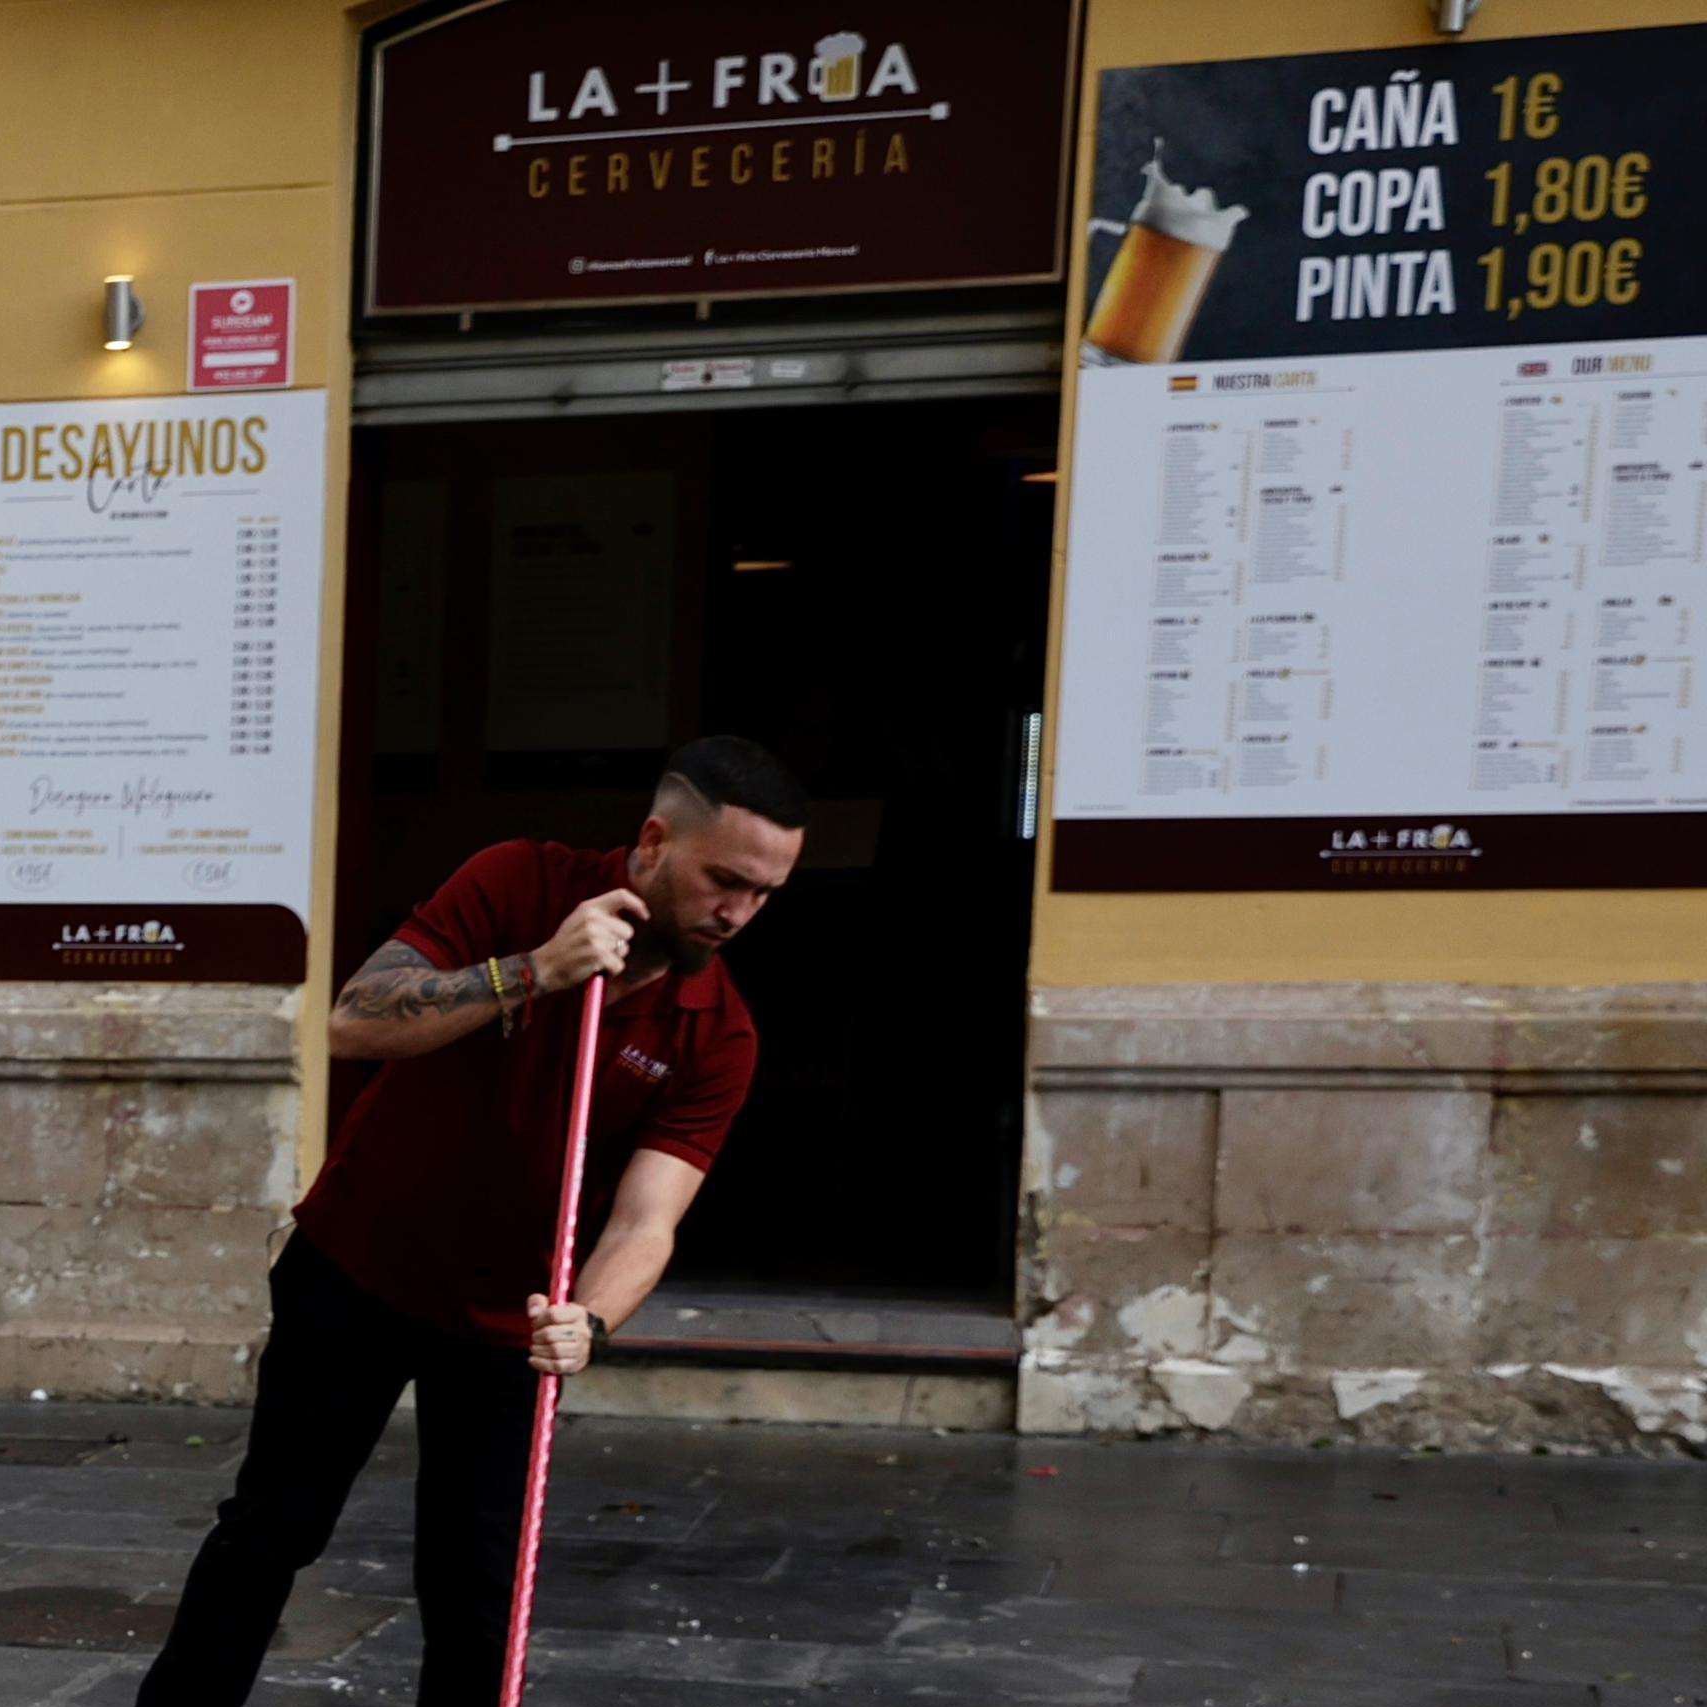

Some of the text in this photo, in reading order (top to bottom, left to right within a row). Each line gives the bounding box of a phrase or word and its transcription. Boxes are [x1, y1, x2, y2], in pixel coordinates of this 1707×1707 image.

[527, 66, 618, 122] LA
[1308, 69, 1563, 155] CAÑA 1€
[528, 128, 909, 199] CERVECERÍA
[1302, 152, 1651, 239] COPA 1,80€
[1296, 238, 1643, 322] PINTA 1,90€
[1213, 371, 1318, 390] NUESTRA CARTA
[1572, 353, 1653, 374] OUR MENU
[0, 416, 268, 484] DESAYUNOS
[87, 450, 173, 513] Carta
[1331, 829, 1369, 849] LA
[62, 924, 90, 942] LA
